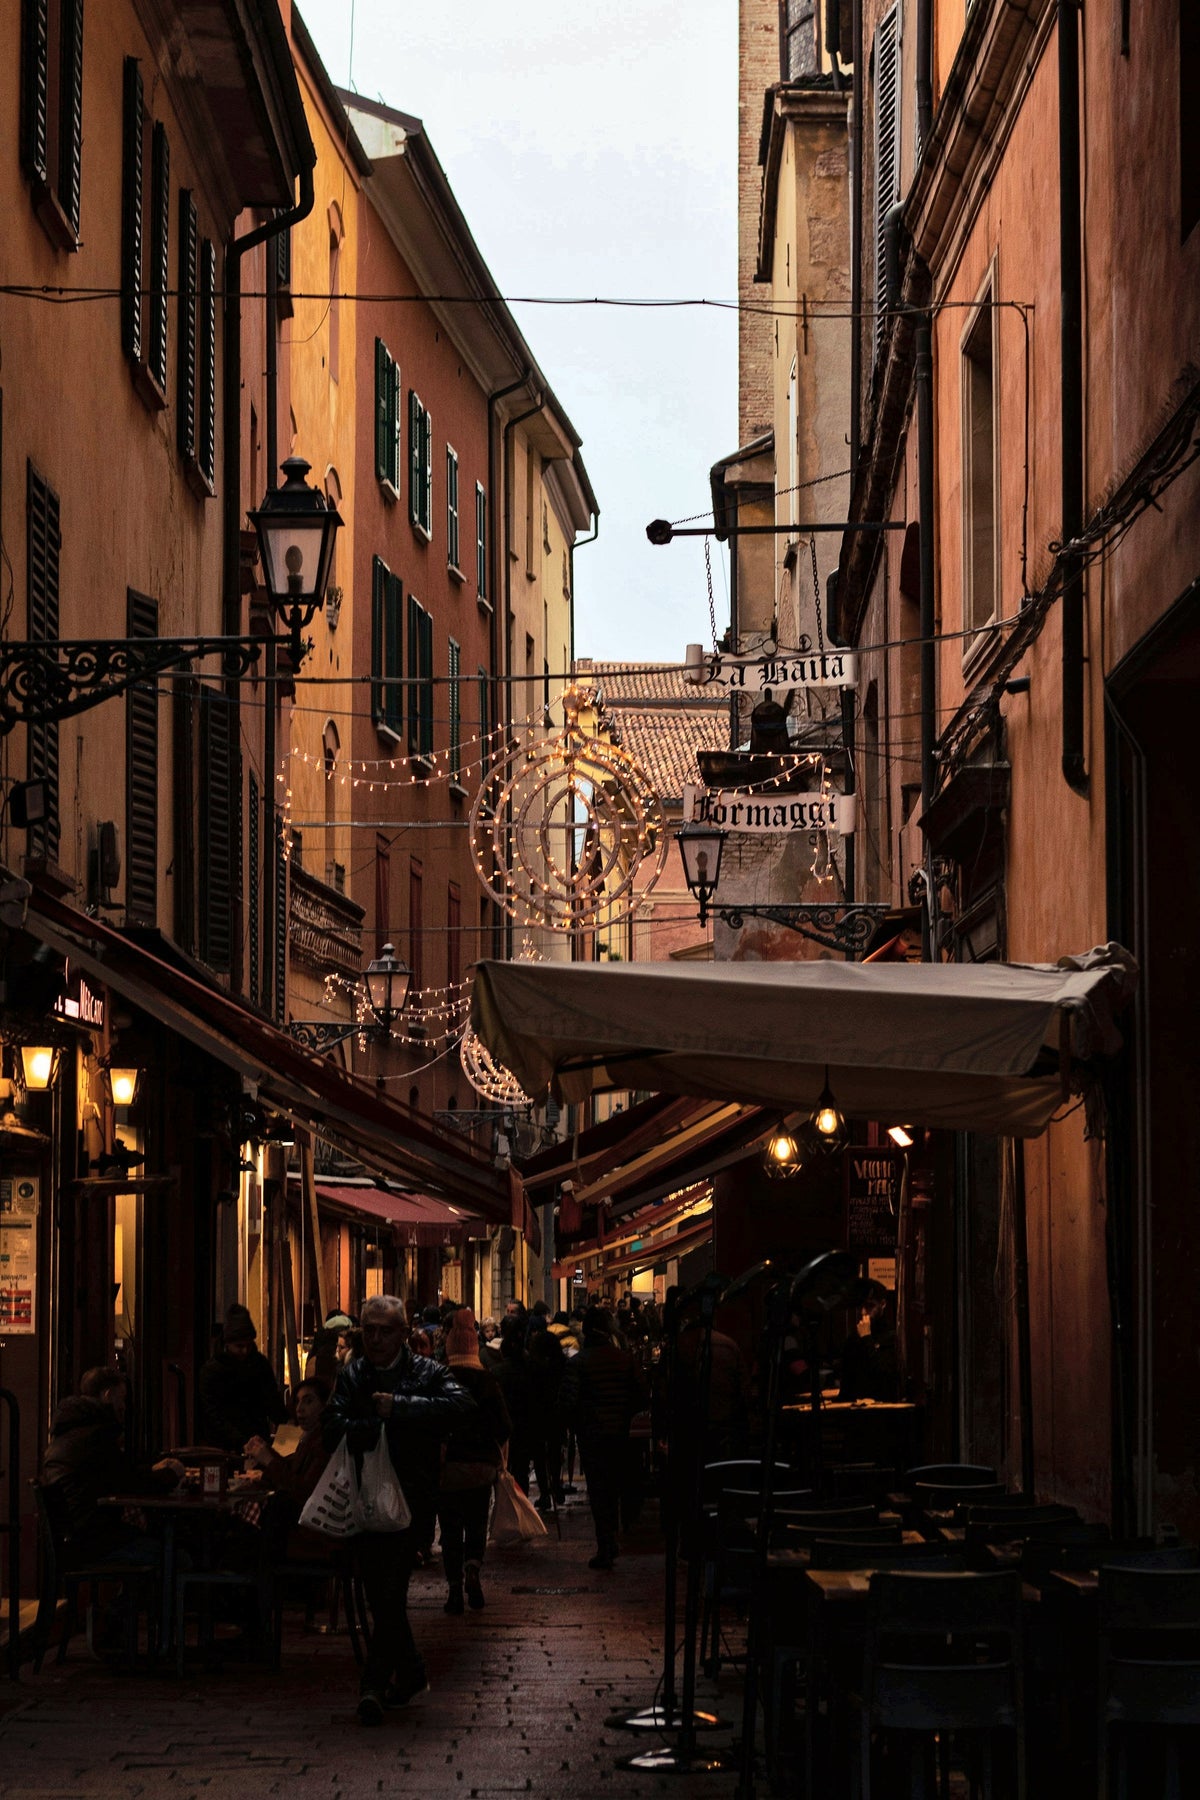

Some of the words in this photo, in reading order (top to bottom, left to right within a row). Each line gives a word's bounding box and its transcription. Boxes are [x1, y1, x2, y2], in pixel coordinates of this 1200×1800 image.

[703, 655, 746, 687] La
[757, 655, 846, 690] Baita
[690, 793, 838, 830] Formaggi
